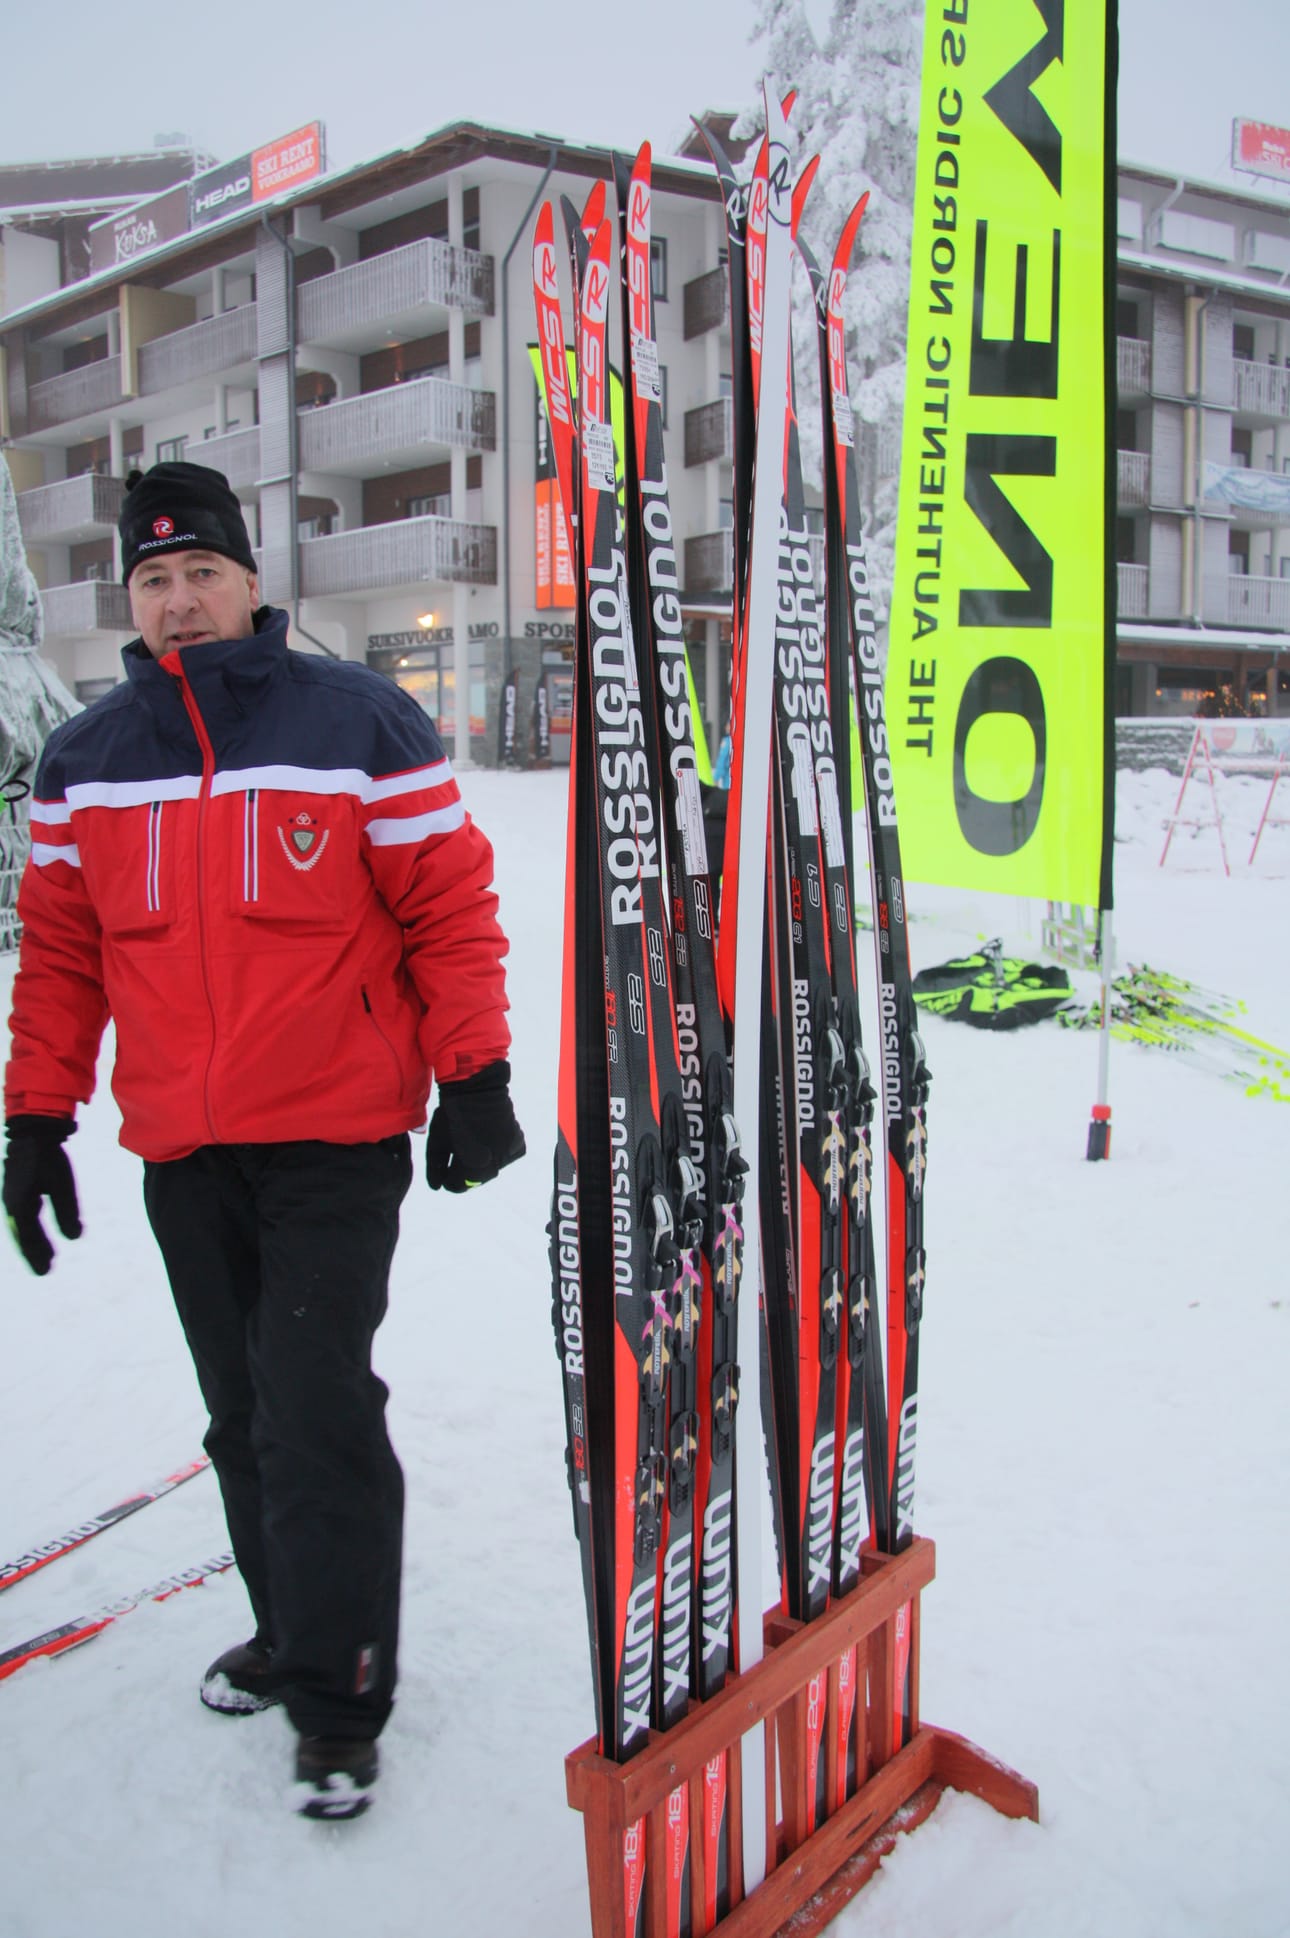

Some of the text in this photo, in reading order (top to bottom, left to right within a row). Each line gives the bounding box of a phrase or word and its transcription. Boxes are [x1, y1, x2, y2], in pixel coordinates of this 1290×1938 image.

[257, 138, 314, 178] SKI RENT
[195, 176, 250, 213] HEAD
[542, 303, 569, 424] WCS
[538, 386, 548, 466] HEA
[138, 533, 198, 551] ROSSIGNOL
[555, 555, 569, 585] SKI
[846, 530, 897, 827] ROSSIGNOL
[588, 548, 643, 926] ROSSIGNOL
[693, 879, 711, 940] S2
[647, 927, 666, 987] S2
[627, 972, 645, 1035] S2
[608, 1030, 619, 1064] S2
[793, 979, 815, 1137] ROSSIGNOL
[880, 983, 902, 1128] ROSSIGNOL
[609, 1097, 633, 1296] ROSSIGNOL
[557, 1174, 584, 1376] ROSSIGNOL
[808, 1673, 820, 1729] 20
